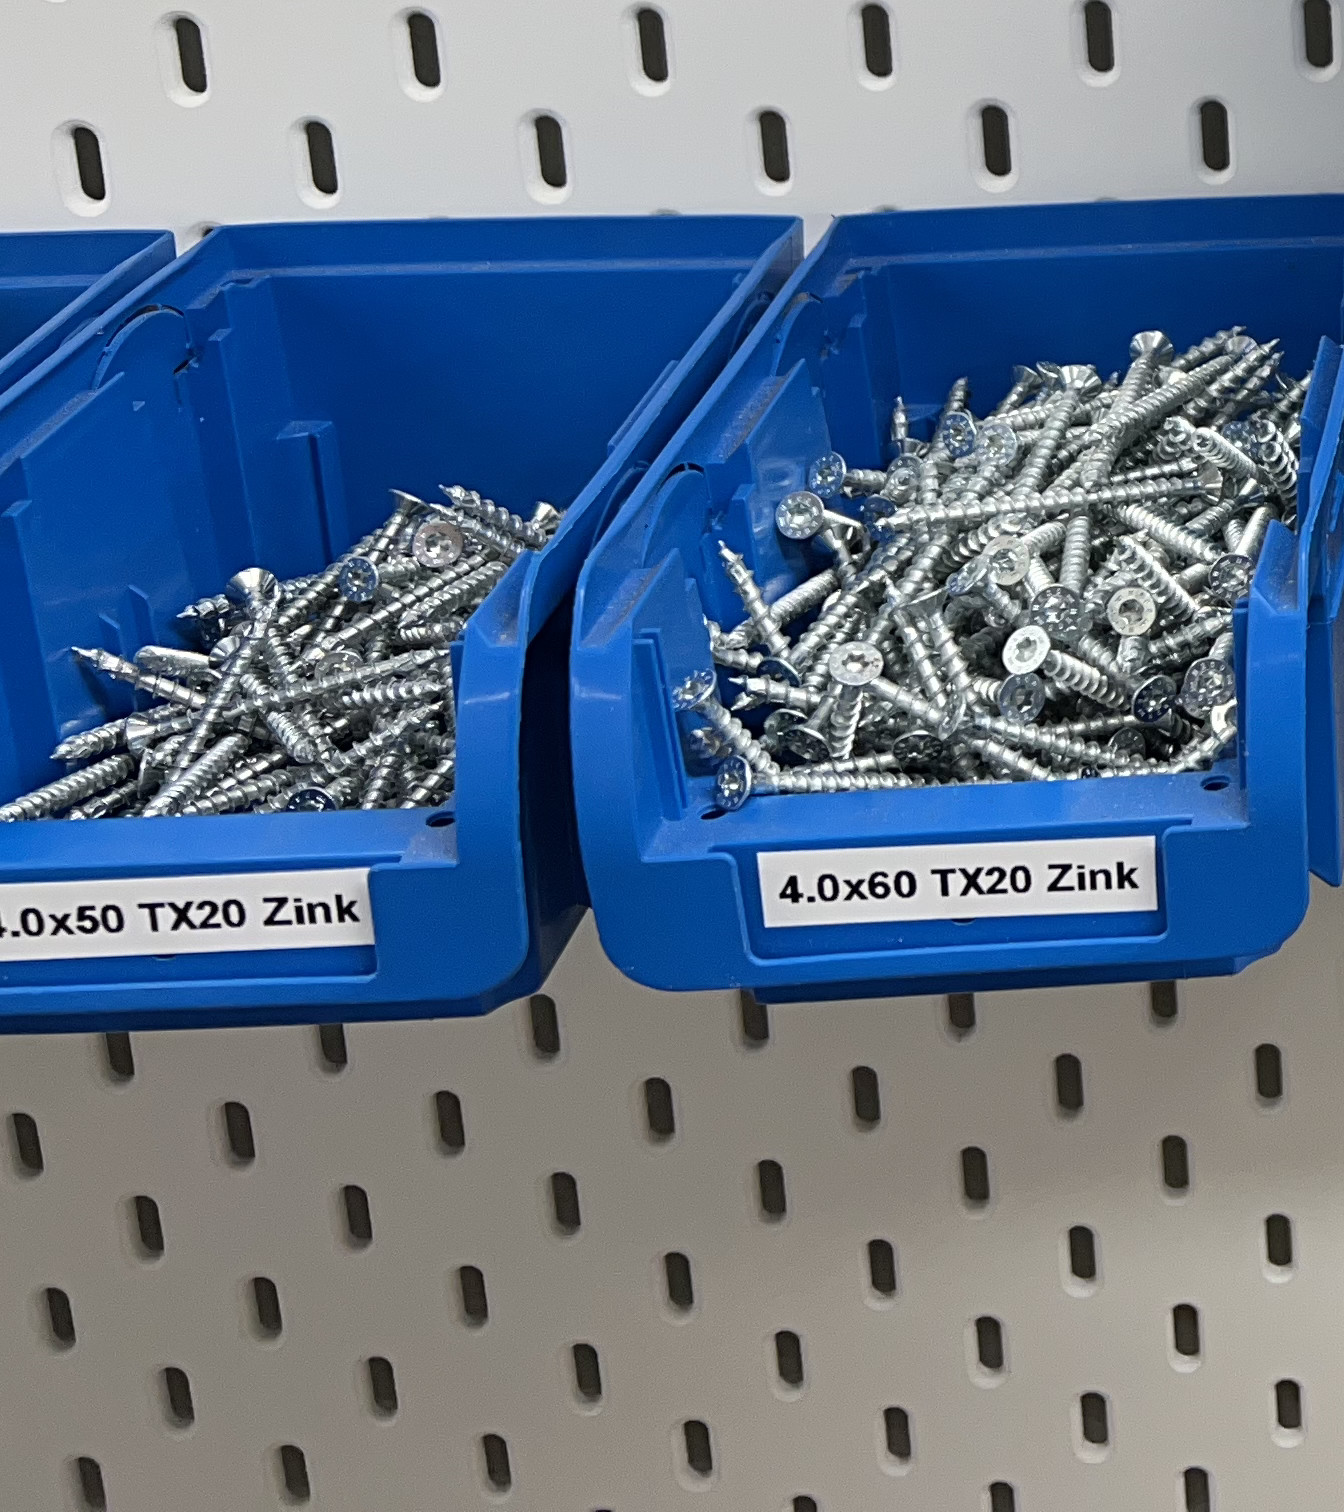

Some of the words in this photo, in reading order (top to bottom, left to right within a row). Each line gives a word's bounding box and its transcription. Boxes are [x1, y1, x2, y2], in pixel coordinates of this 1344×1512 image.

[778, 870, 917, 904] 4.0x60
[930, 865, 1032, 897] TX20
[1047, 861, 1140, 893] Zink
[0, 904, 125, 938] .0x50
[137, 899, 246, 933] TX20
[262, 894, 361, 927] Zink
